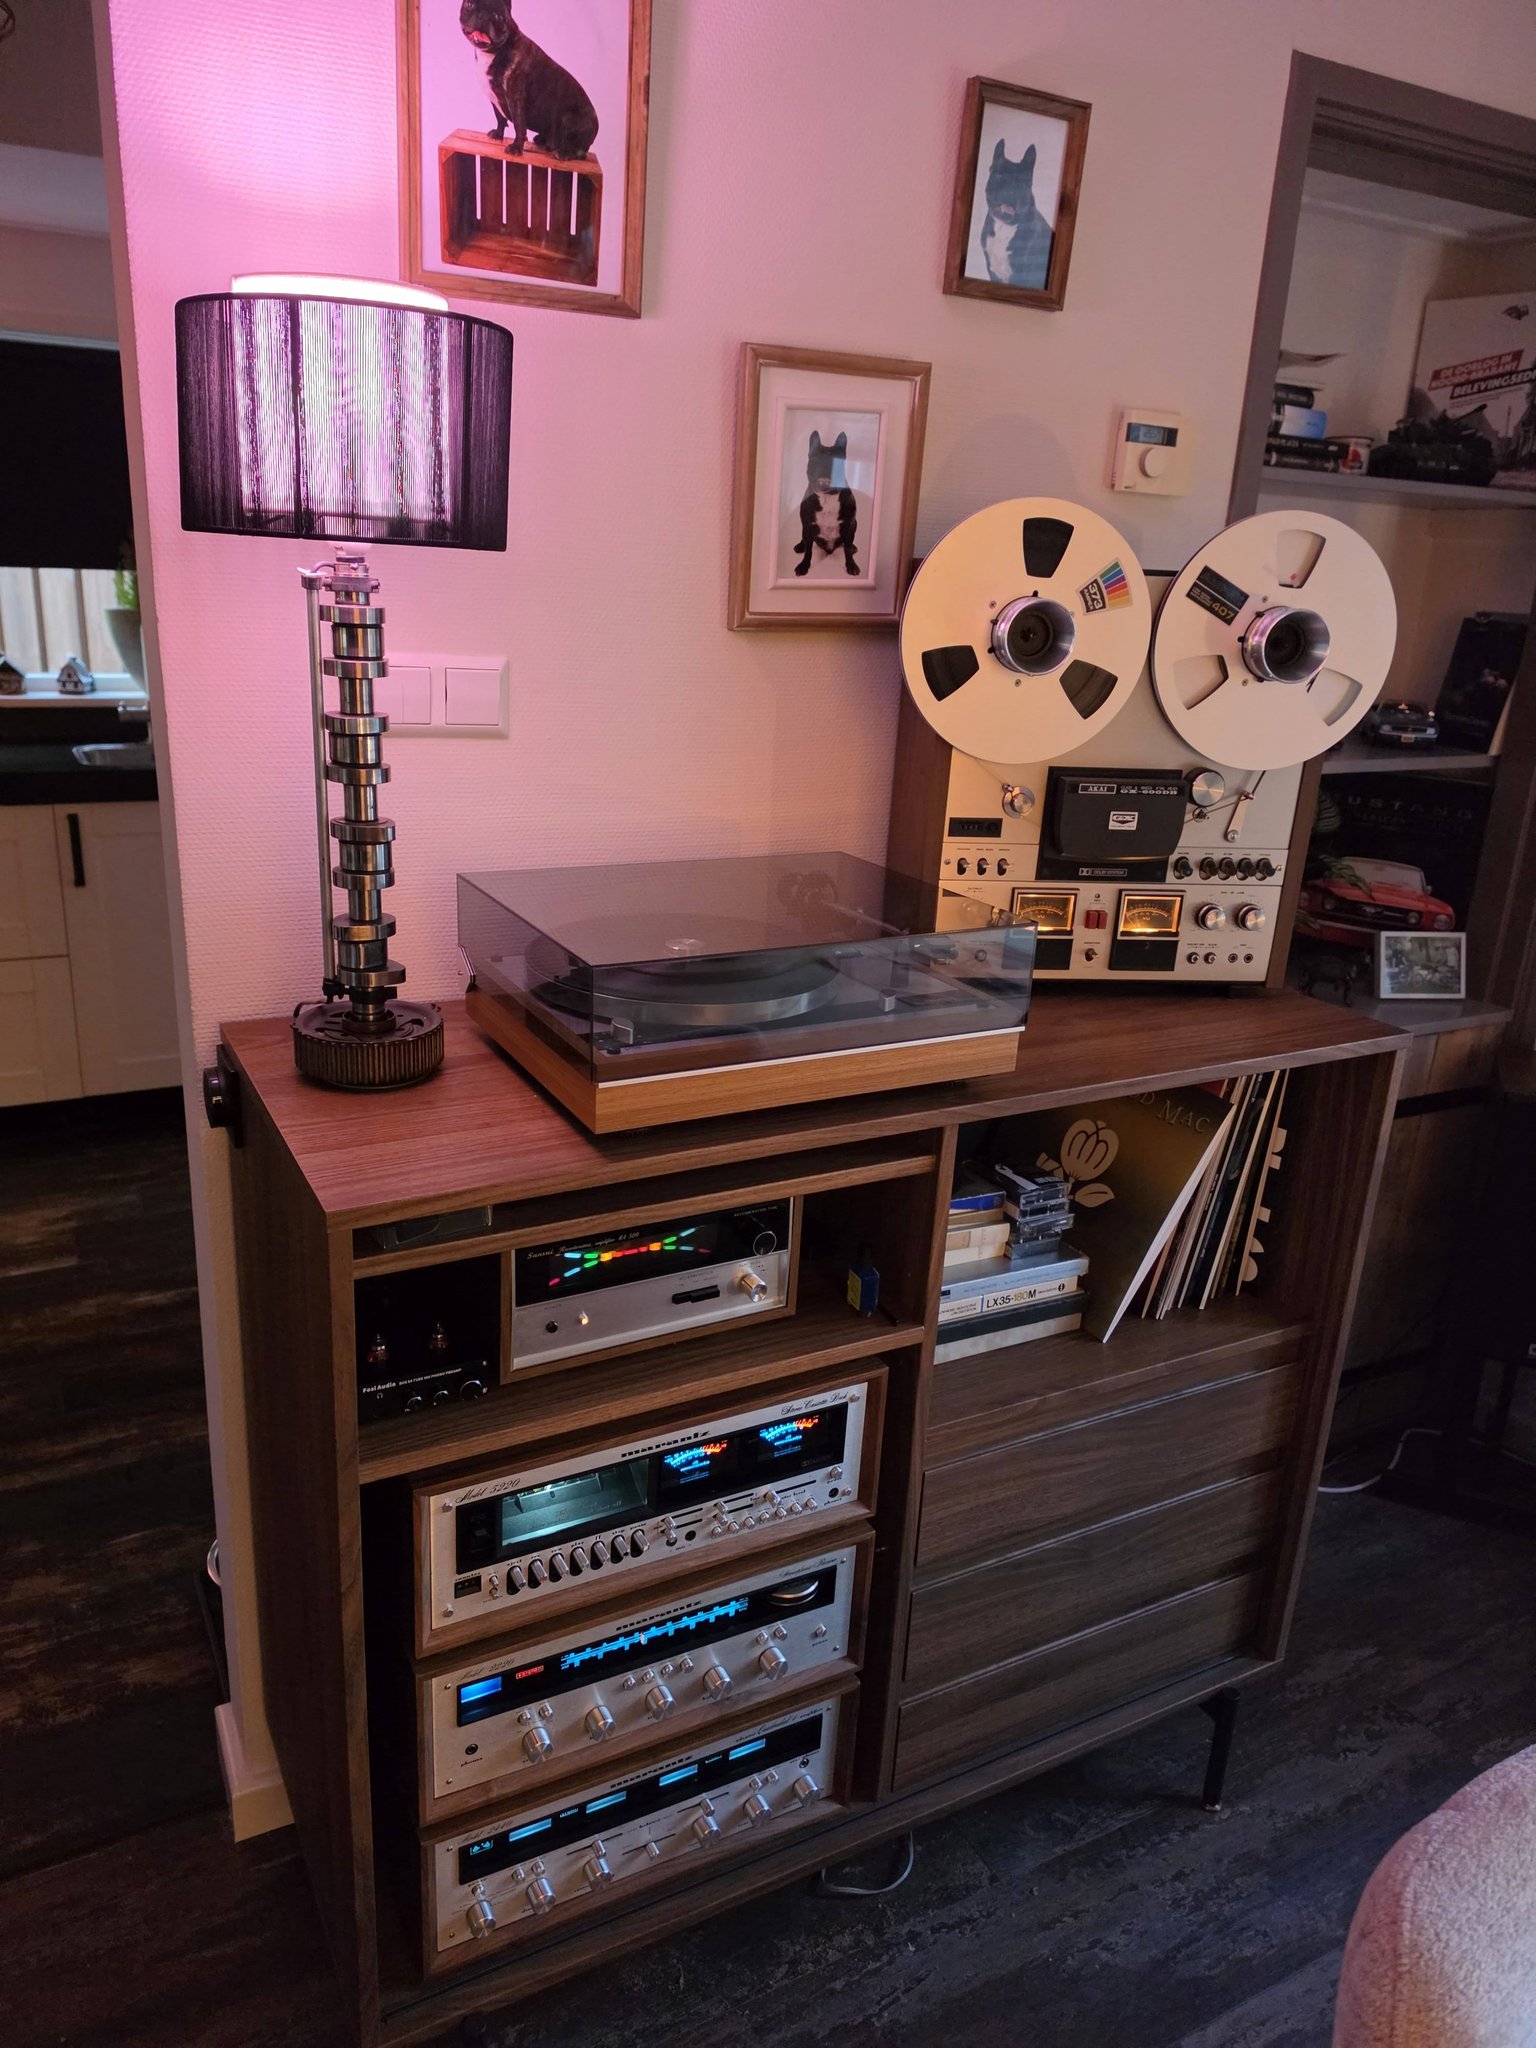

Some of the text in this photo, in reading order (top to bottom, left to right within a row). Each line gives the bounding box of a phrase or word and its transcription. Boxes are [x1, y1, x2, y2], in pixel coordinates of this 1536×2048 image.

[1088, 583, 1103, 609] 373
[1211, 602, 1234, 619] 407
[1335, 793, 1473, 820] USTANG
[1156, 1099, 1210, 1133] MAC
[526, 1249, 554, 1260] Sansui
[986, 1289, 1037, 1308] LX35-180M
[362, 1385, 376, 1393] Fosi
[377, 1382, 396, 1391] Audio
[455, 1478, 521, 1503] Model 5220
